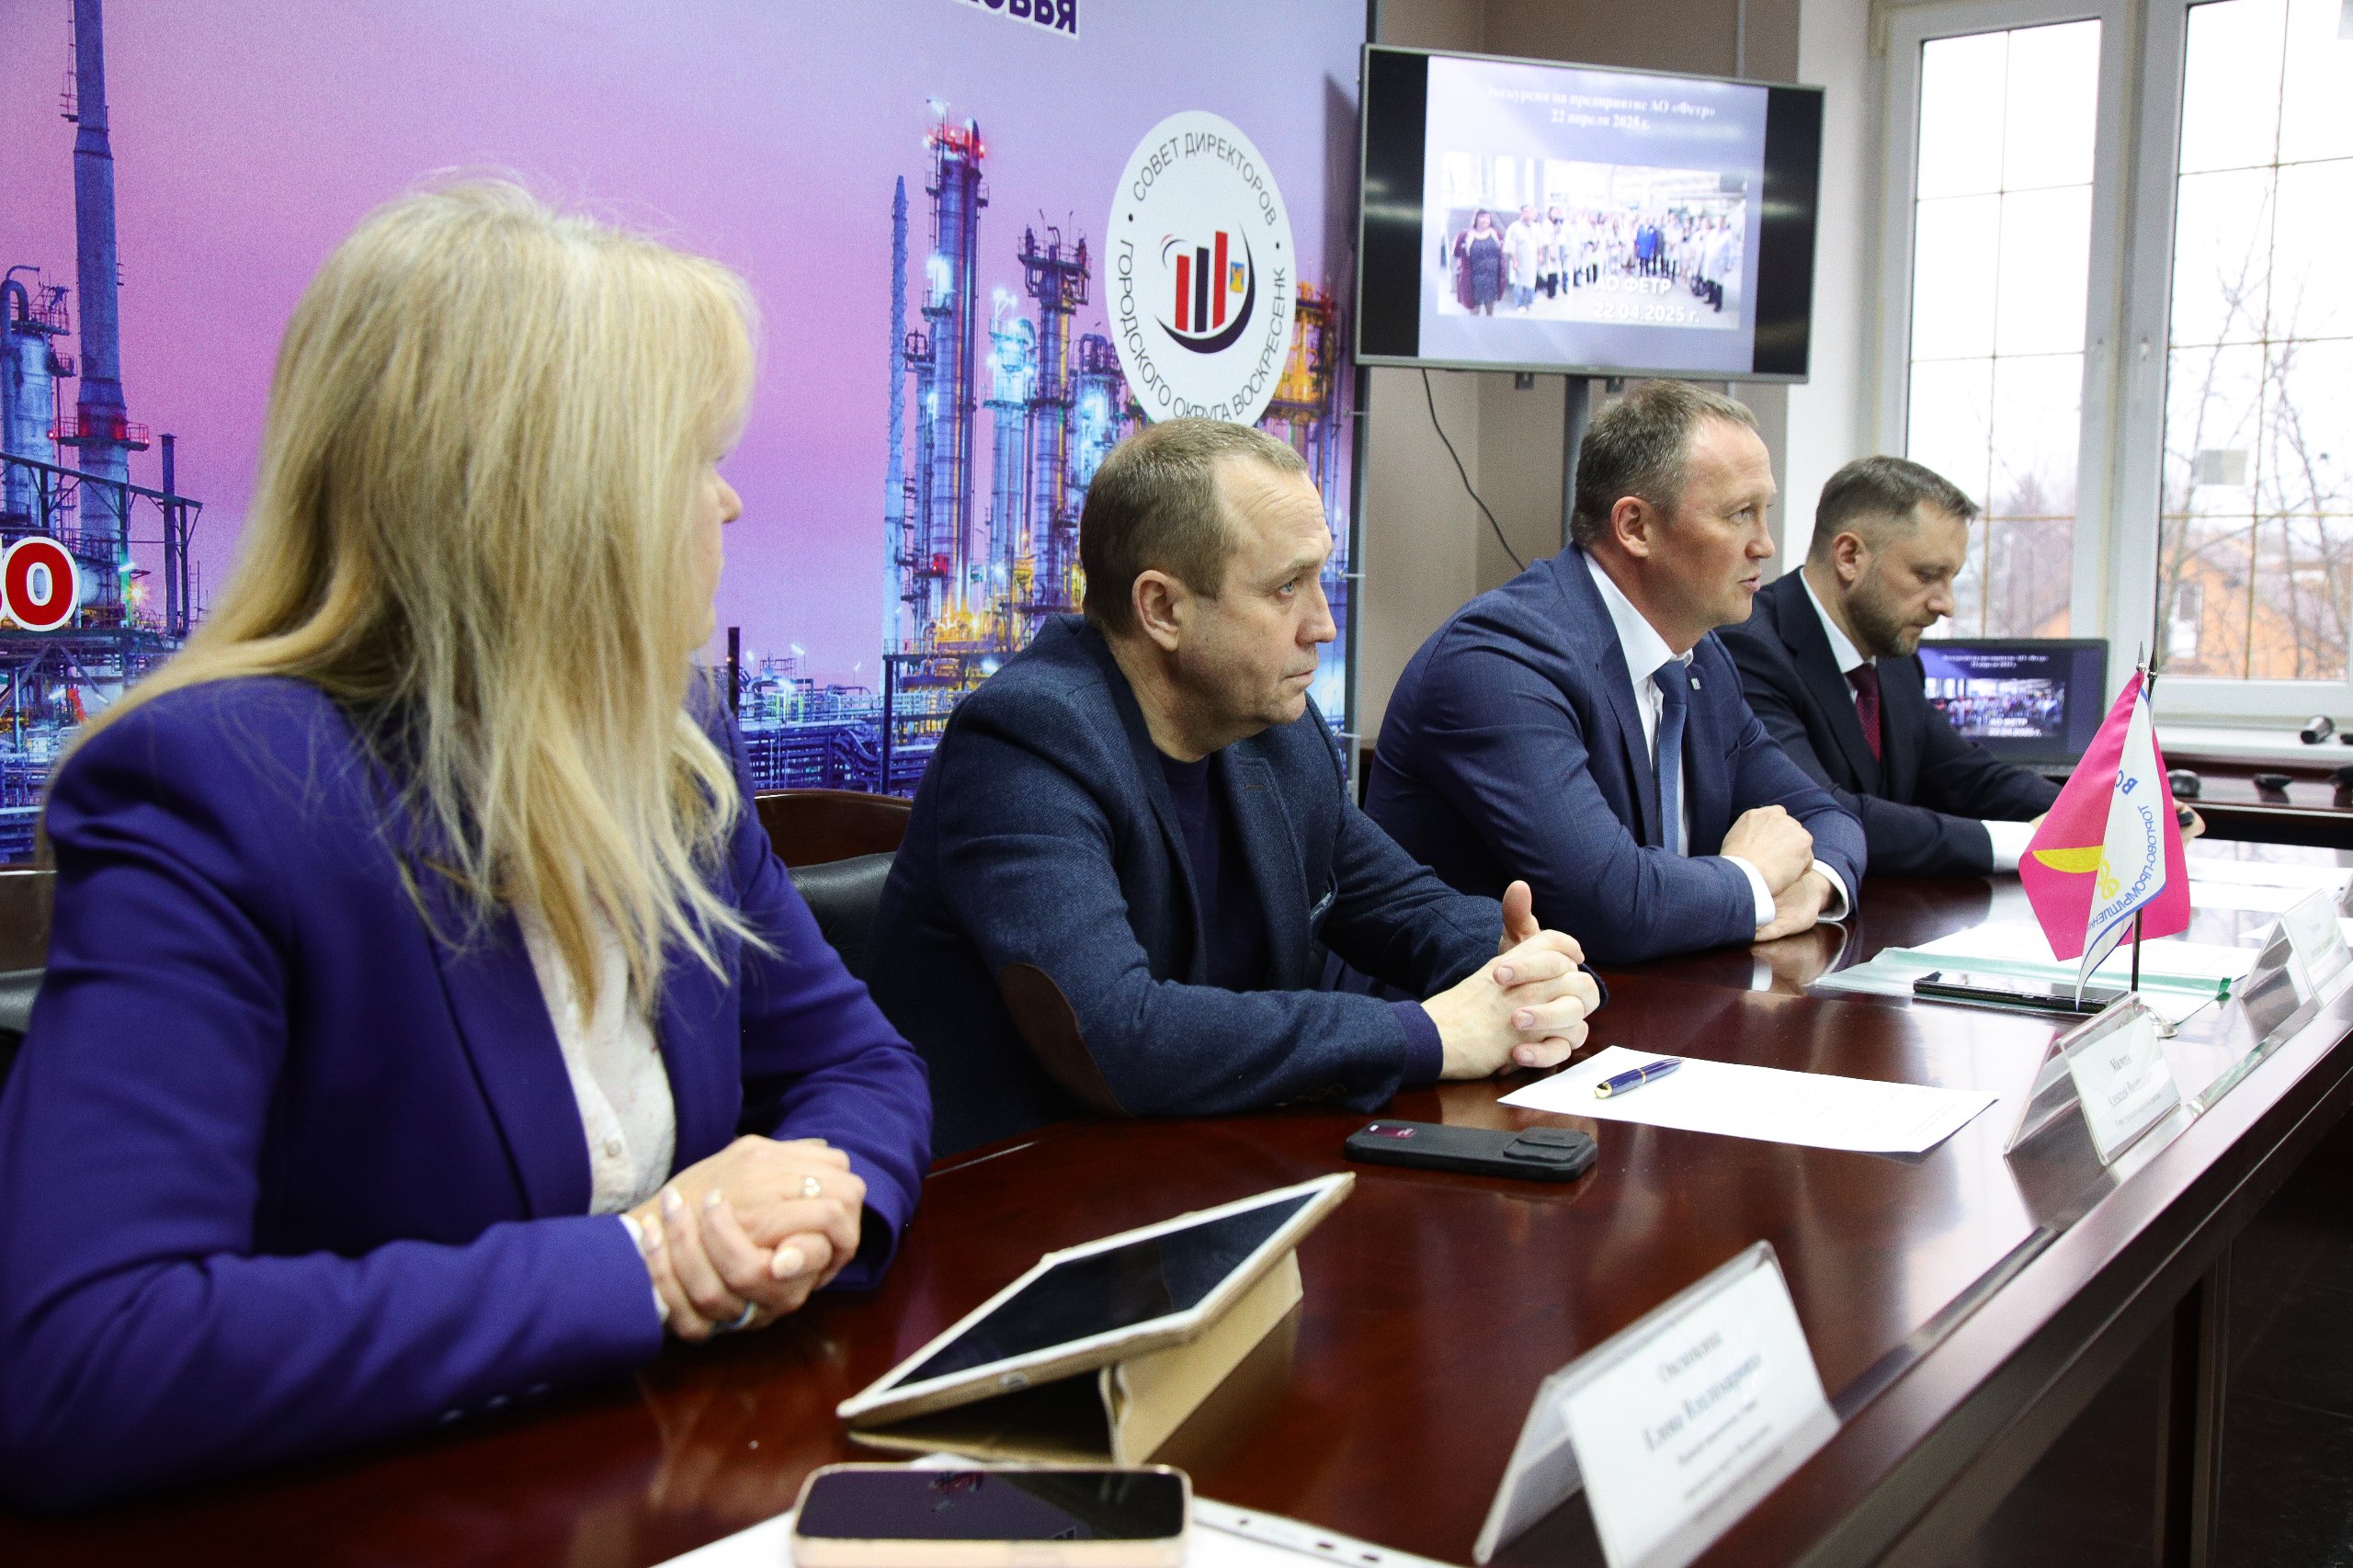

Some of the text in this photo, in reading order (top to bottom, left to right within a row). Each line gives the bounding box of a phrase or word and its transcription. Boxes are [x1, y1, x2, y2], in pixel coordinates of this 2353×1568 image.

[1133, 131, 1278, 226] СОВЕТ ДИРЕКТОРОВ
[1593, 301, 1687, 324] 22.04.2025
[1594, 275, 1672, 295] АО ФЕТР
[1118, 239, 1172, 407] ГОРОДСКОГО
[1232, 267, 1286, 416] ВОСКРЕСЕНК
